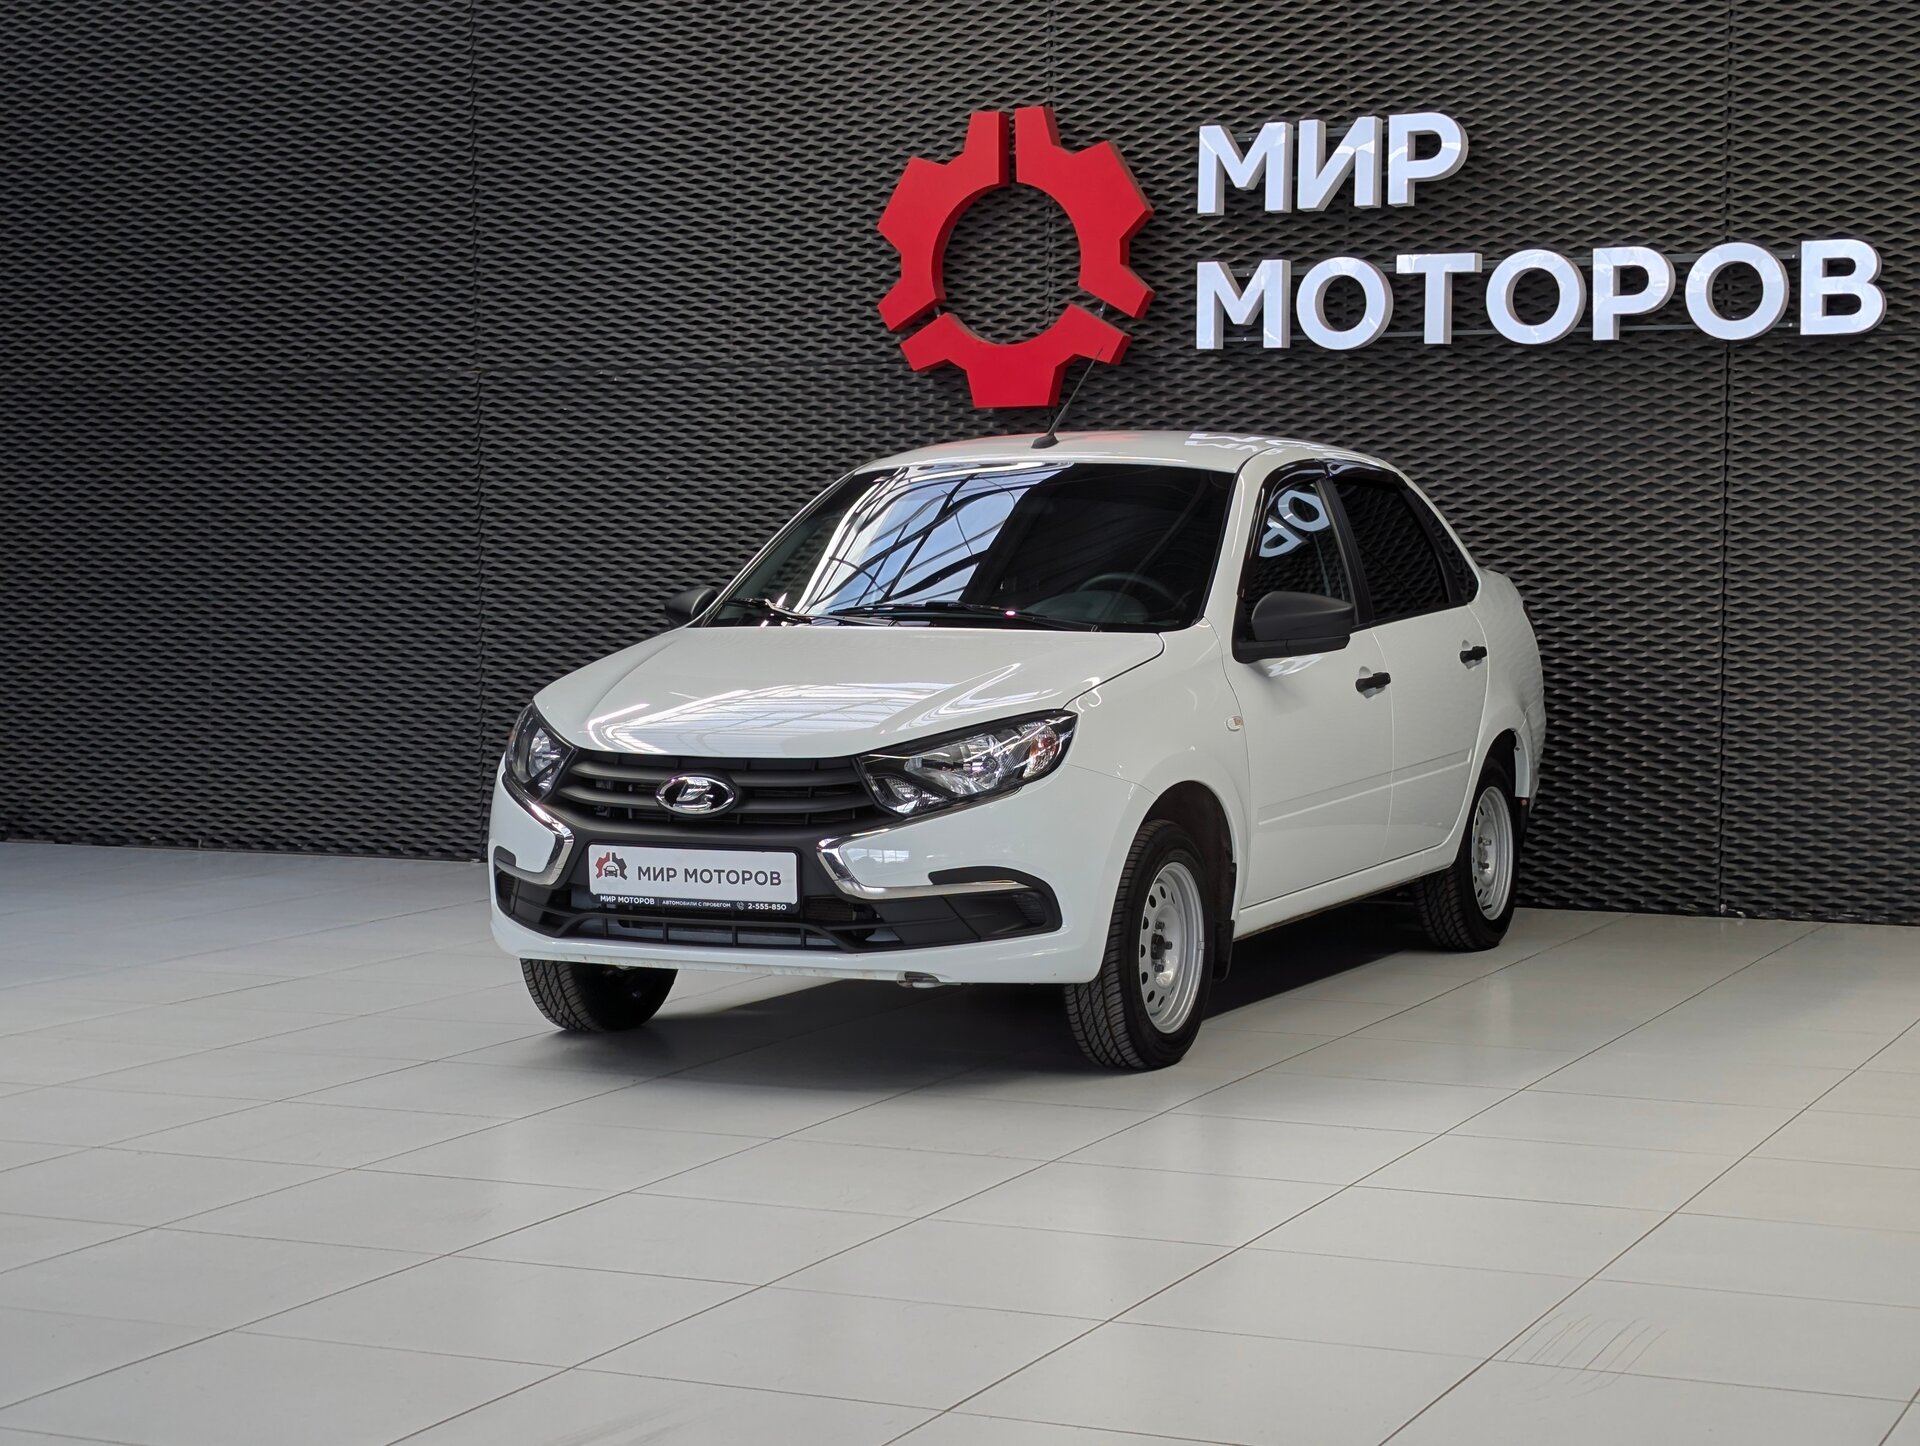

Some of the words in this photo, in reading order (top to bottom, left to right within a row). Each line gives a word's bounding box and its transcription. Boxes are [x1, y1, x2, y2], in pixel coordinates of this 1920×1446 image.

[1197, 112, 1468, 215] МИР
[1196, 239, 1884, 350] МОТОРОВ
[637, 866, 677, 882] МИР
[684, 868, 782, 886] МОТОРОВ
[600, 895, 616, 903] МИР
[617, 896, 655, 905] МОТОРОВ
[747, 902, 787, 911] 2-555-850
